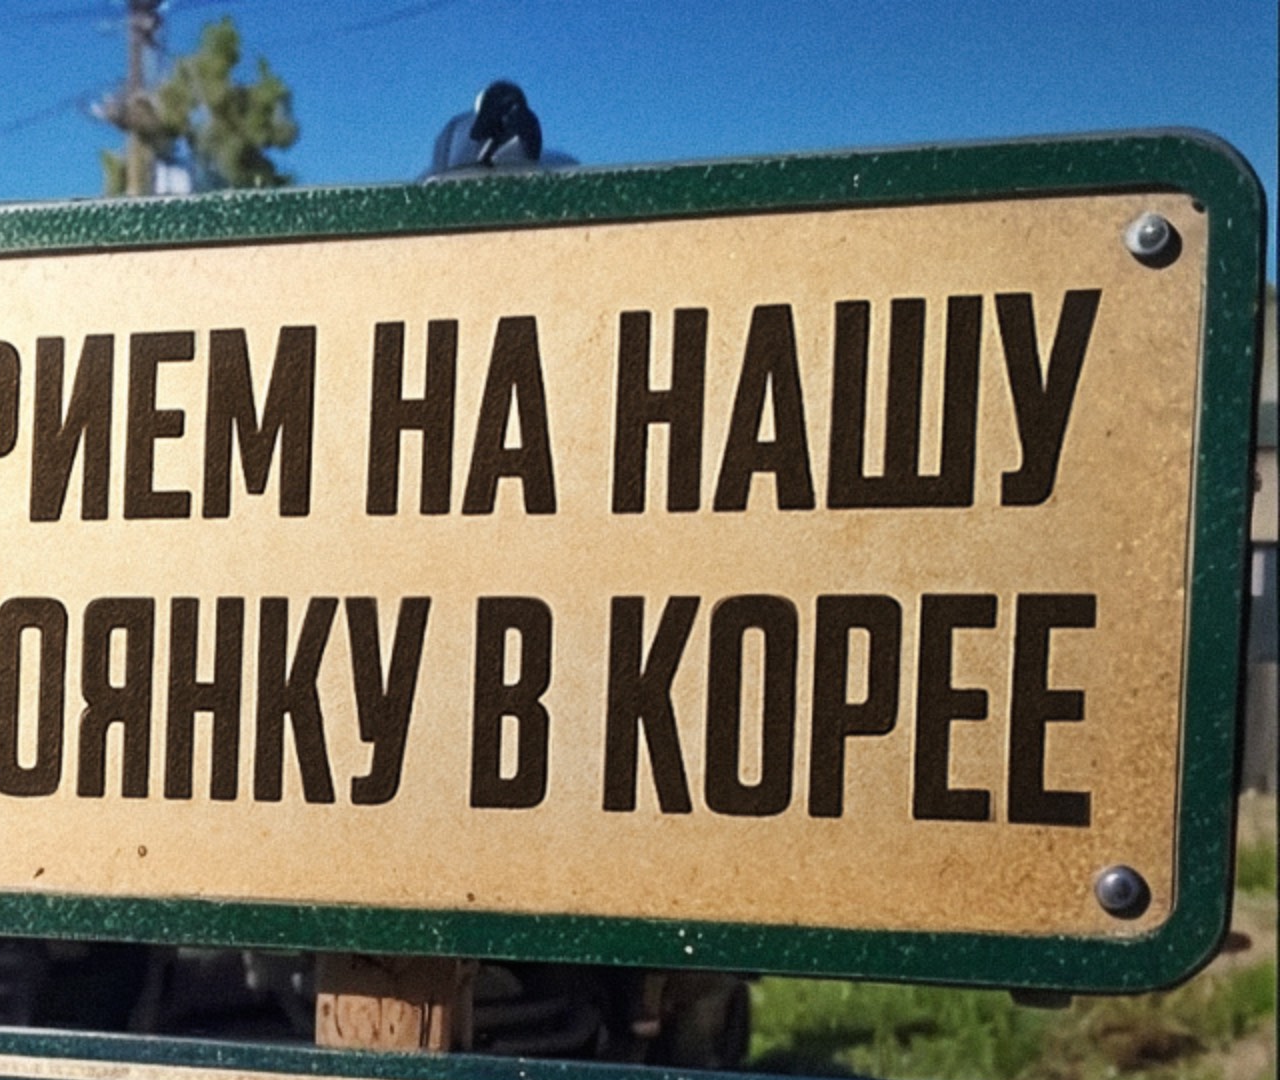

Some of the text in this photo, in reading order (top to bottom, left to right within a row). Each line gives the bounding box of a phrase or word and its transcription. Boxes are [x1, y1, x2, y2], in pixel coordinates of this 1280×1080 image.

[366, 315, 557, 516] НА
[611, 288, 1102, 514] НАШУ
[469, 596, 553, 810] В
[602, 593, 1097, 829] КОРЕЕ
